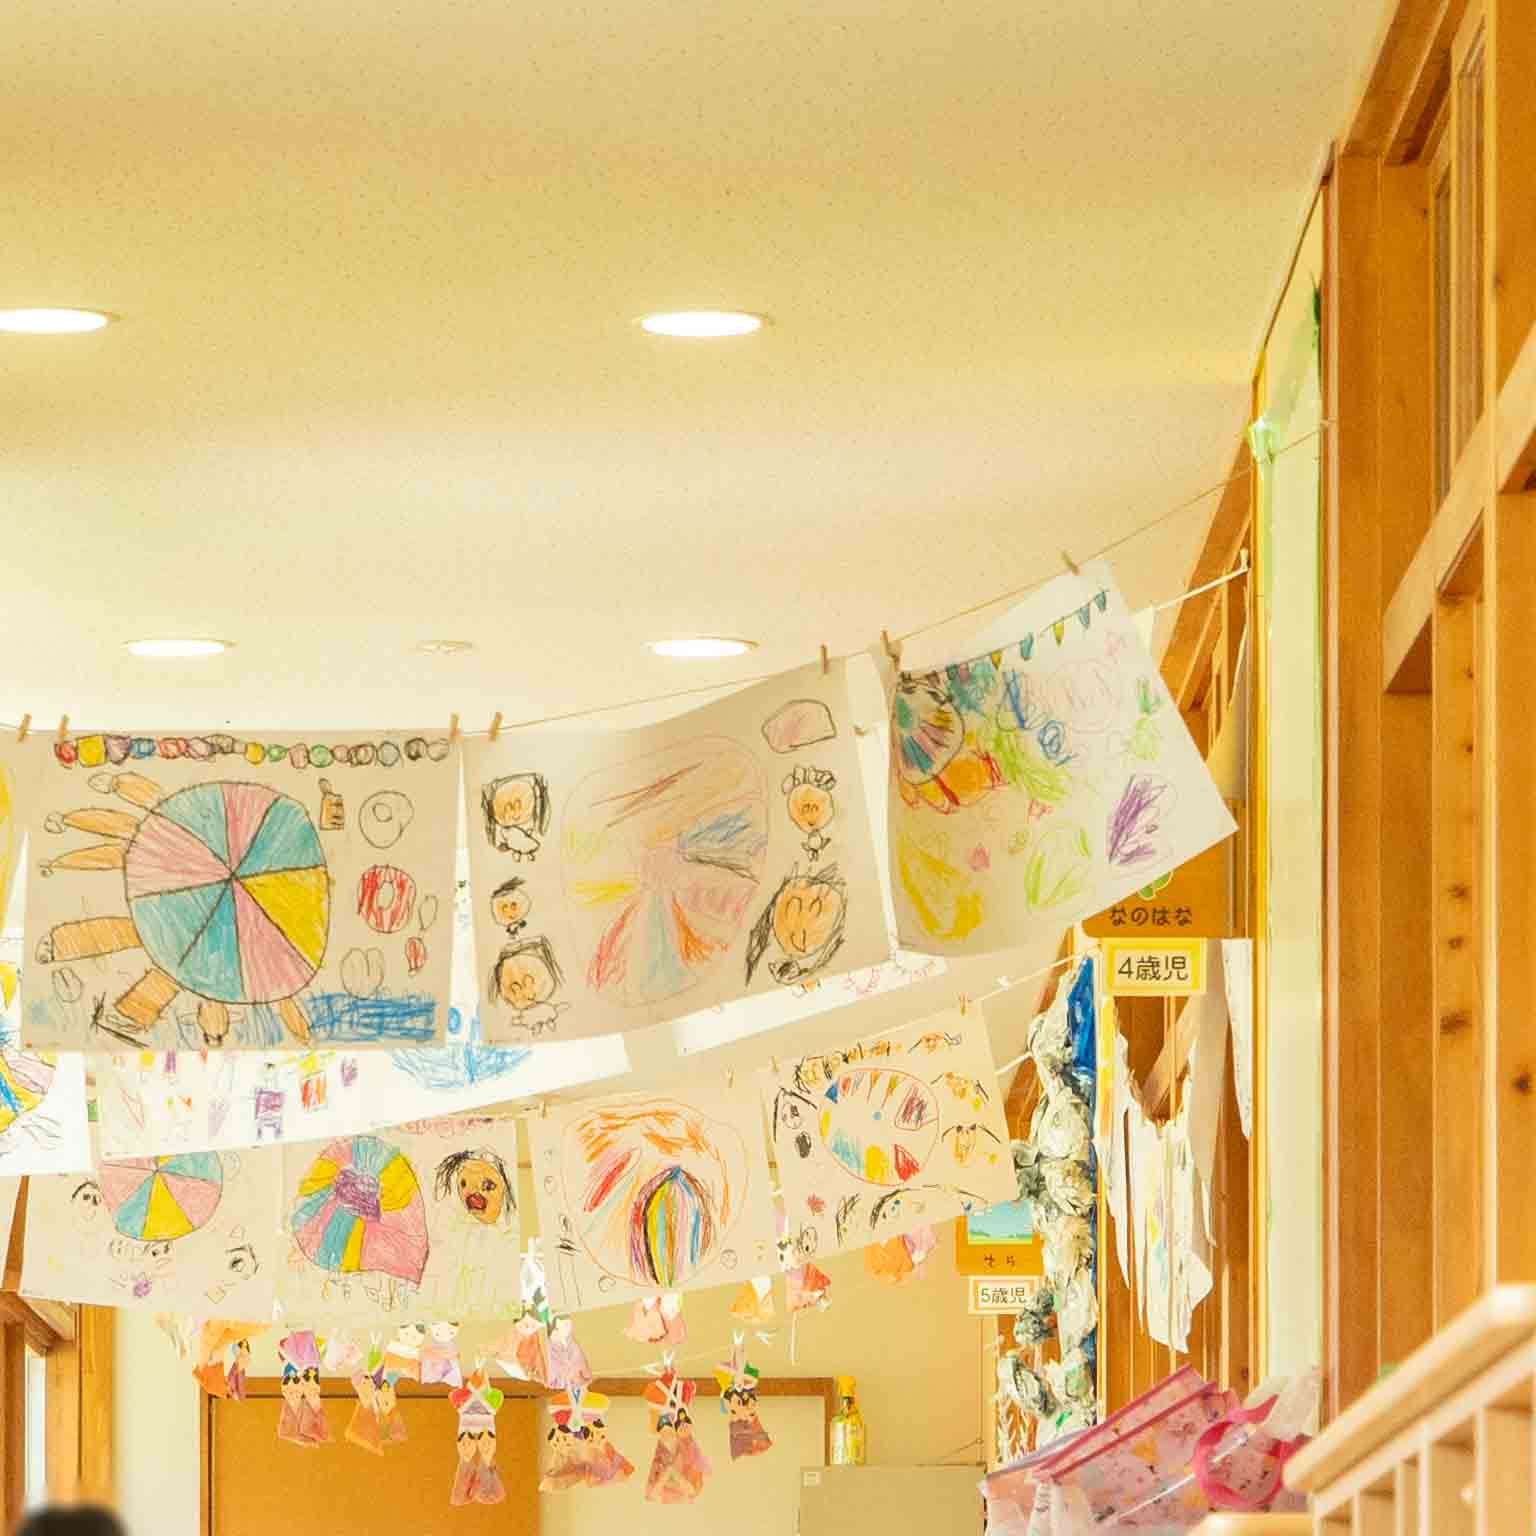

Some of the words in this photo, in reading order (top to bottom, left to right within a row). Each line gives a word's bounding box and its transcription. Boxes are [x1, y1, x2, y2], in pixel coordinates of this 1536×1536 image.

[1109, 905, 1193, 927] なのはな
[1117, 955, 1189, 981] 4歳児
[980, 1287, 1027, 1304] 5歳児
